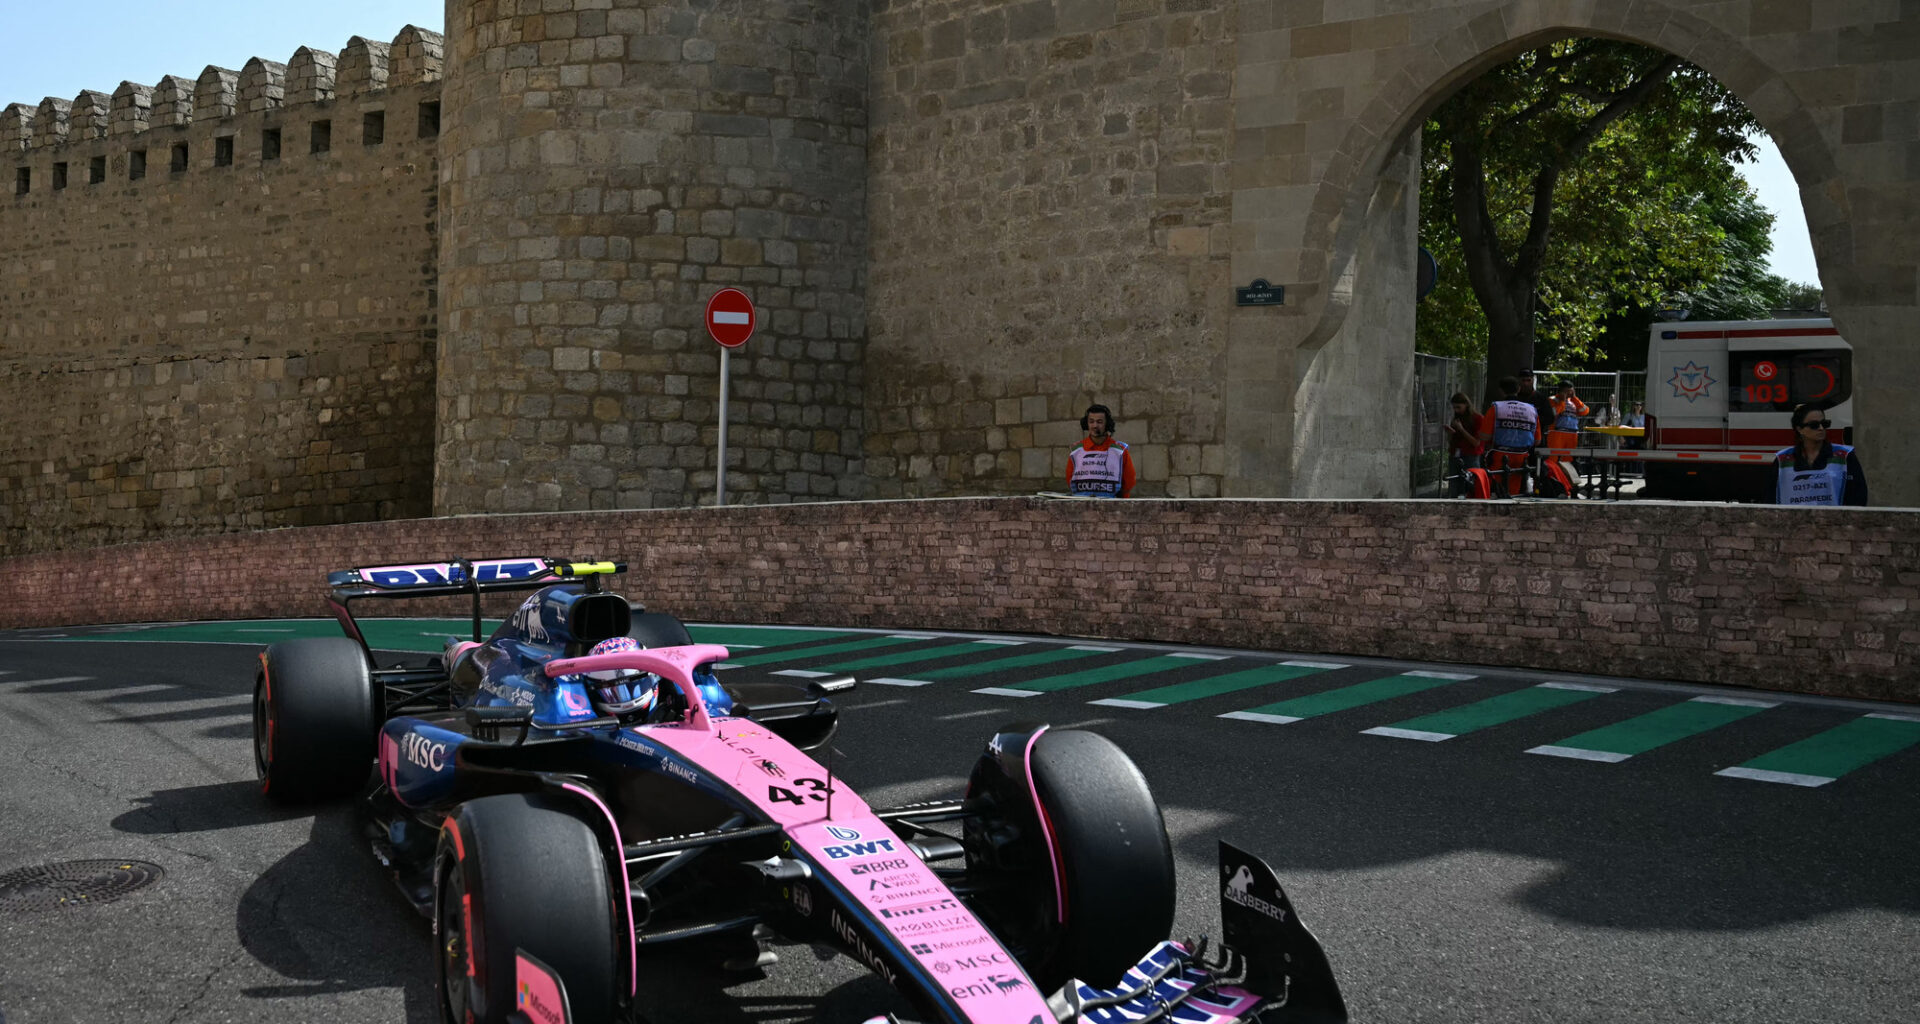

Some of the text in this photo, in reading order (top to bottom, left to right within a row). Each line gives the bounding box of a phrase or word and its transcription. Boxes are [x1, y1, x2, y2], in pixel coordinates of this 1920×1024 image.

[1745, 384, 1789, 403] 103
[1077, 482, 1114, 492] COURSE
[1790, 494, 1833, 504] PARAMEDIC
[408, 732, 447, 772] MSC
[668, 762, 698, 784] BINANCE
[768, 778, 836, 806] 43
[822, 839, 896, 859] BWT
[869, 859, 909, 873] BRB
[886, 887, 942, 901] BINANCE
[1224, 885, 1287, 923] OAKBERRY
[880, 899, 958, 919] PIRELLI
[831, 908, 897, 986] INFINOX
[932, 935, 991, 950] Microsoft
[954, 952, 1009, 971] MSC
[951, 978, 993, 999] eni
